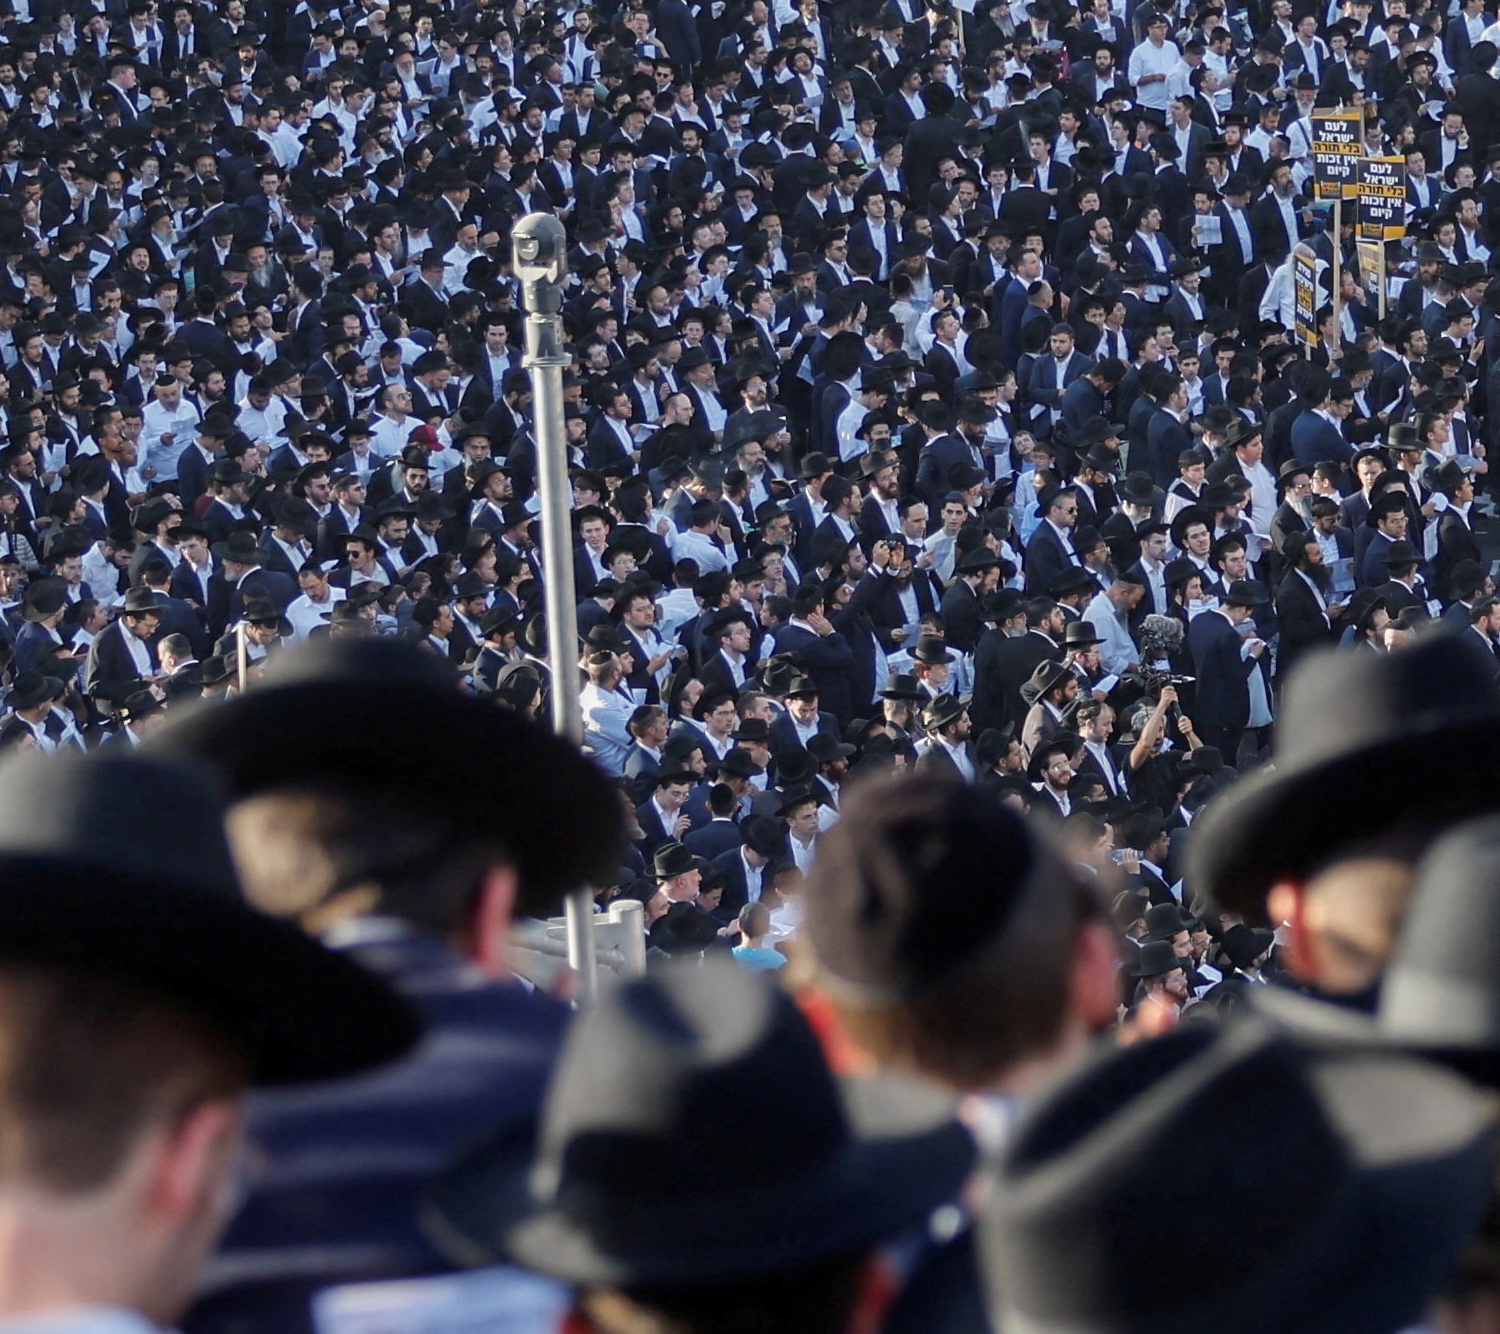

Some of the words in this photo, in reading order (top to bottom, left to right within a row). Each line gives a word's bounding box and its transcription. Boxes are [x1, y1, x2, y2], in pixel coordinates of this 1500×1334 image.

[1324, 120, 1348, 132] לעם
[1318, 131, 1354, 143] ישראל
[1314, 142, 1341, 153] תורה
[1343, 143, 1361, 154] בלי
[1316, 154, 1341, 165] זכות
[1344, 155, 1359, 167] אין
[1327, 165, 1350, 178] קיום
[1370, 163, 1393, 175] לעם
[1364, 173, 1399, 185] ישראל
[1358, 185, 1384, 195] תורה
[1386, 186, 1404, 197] בלי
[1360, 196, 1384, 207] זכות
[1386, 197, 1402, 209] אין
[1370, 208, 1393, 220] קיום
